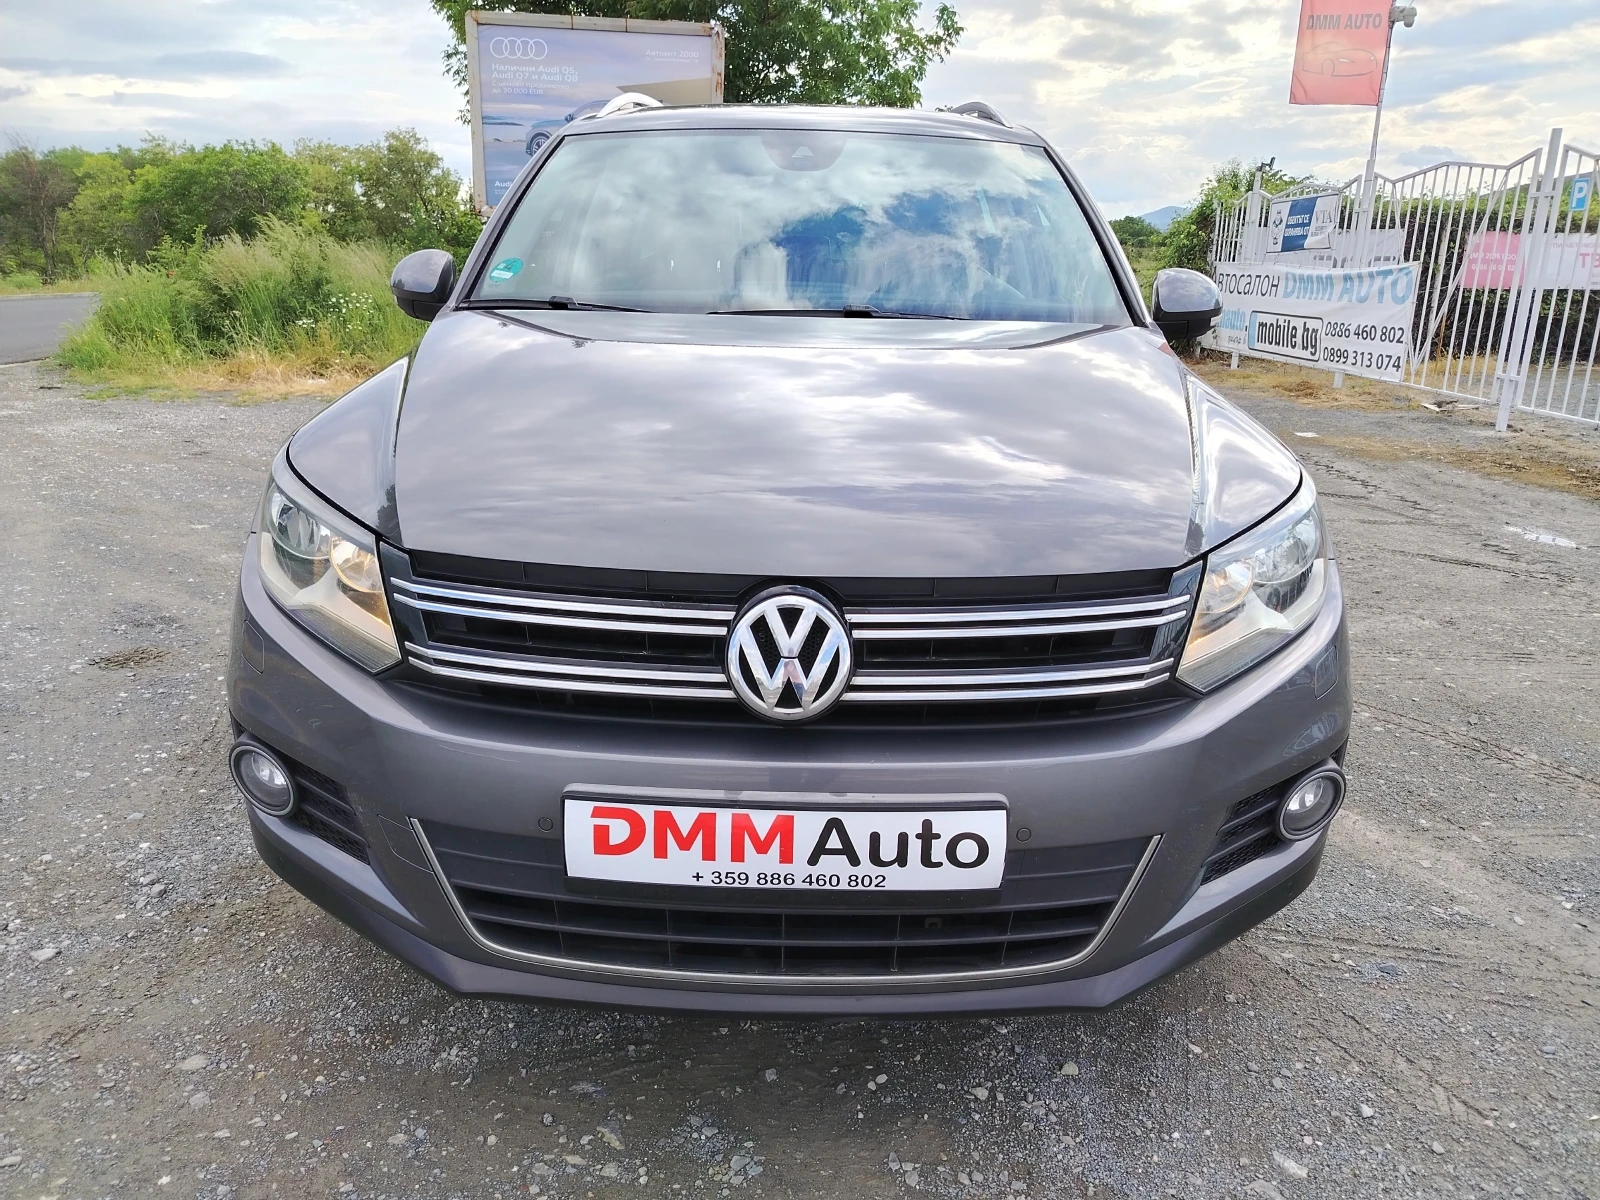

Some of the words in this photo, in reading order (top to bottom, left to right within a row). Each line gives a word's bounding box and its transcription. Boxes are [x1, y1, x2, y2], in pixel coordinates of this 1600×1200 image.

[1306, 14, 1341, 30] DMM
[1344, 13, 1382, 30] AUTO
[679, 50, 699, 58] 2000
[491, 64, 535, 72] Налични
[538, 65, 560, 73] Audi
[491, 71, 514, 79] Audi
[516, 72, 529, 80] Q7
[541, 73, 562, 81] Audi
[564, 74, 579, 82] Q8
[1571, 182, 1588, 208] P
[1282, 271, 1335, 301] DMM
[1338, 266, 1413, 305] AUTO
[1325, 321, 1352, 338] 0886
[1353, 324, 1377, 341] 460
[1380, 326, 1405, 344] 802
[1323, 346, 1349, 364] 0899
[1351, 350, 1373, 368] 313
[1376, 353, 1401, 372] 074
[590, 805, 795, 865] DMM
[806, 816, 990, 869] Auto
[711, 871, 750, 887] 359
[756, 871, 795, 887] 886
[801, 872, 841, 888] 460
[847, 873, 887, 889] 802
